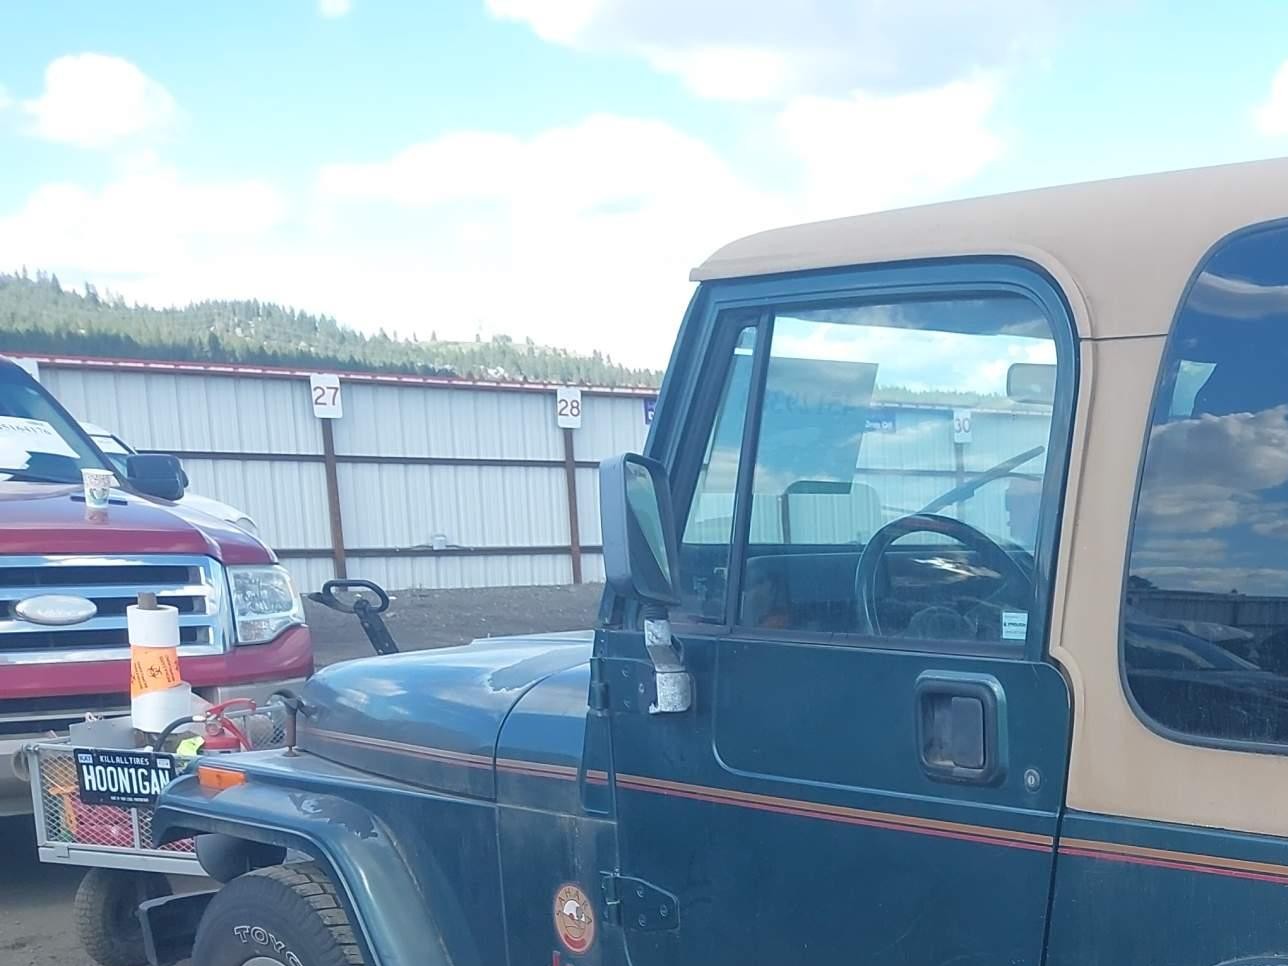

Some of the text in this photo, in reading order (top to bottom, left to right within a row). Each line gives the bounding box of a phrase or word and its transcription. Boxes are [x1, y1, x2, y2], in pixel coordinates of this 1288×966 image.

[313, 386, 339, 406] 27
[559, 399, 581, 417] 28
[955, 418, 972, 433] 30
[82, 764, 170, 795] HOON1GAN
